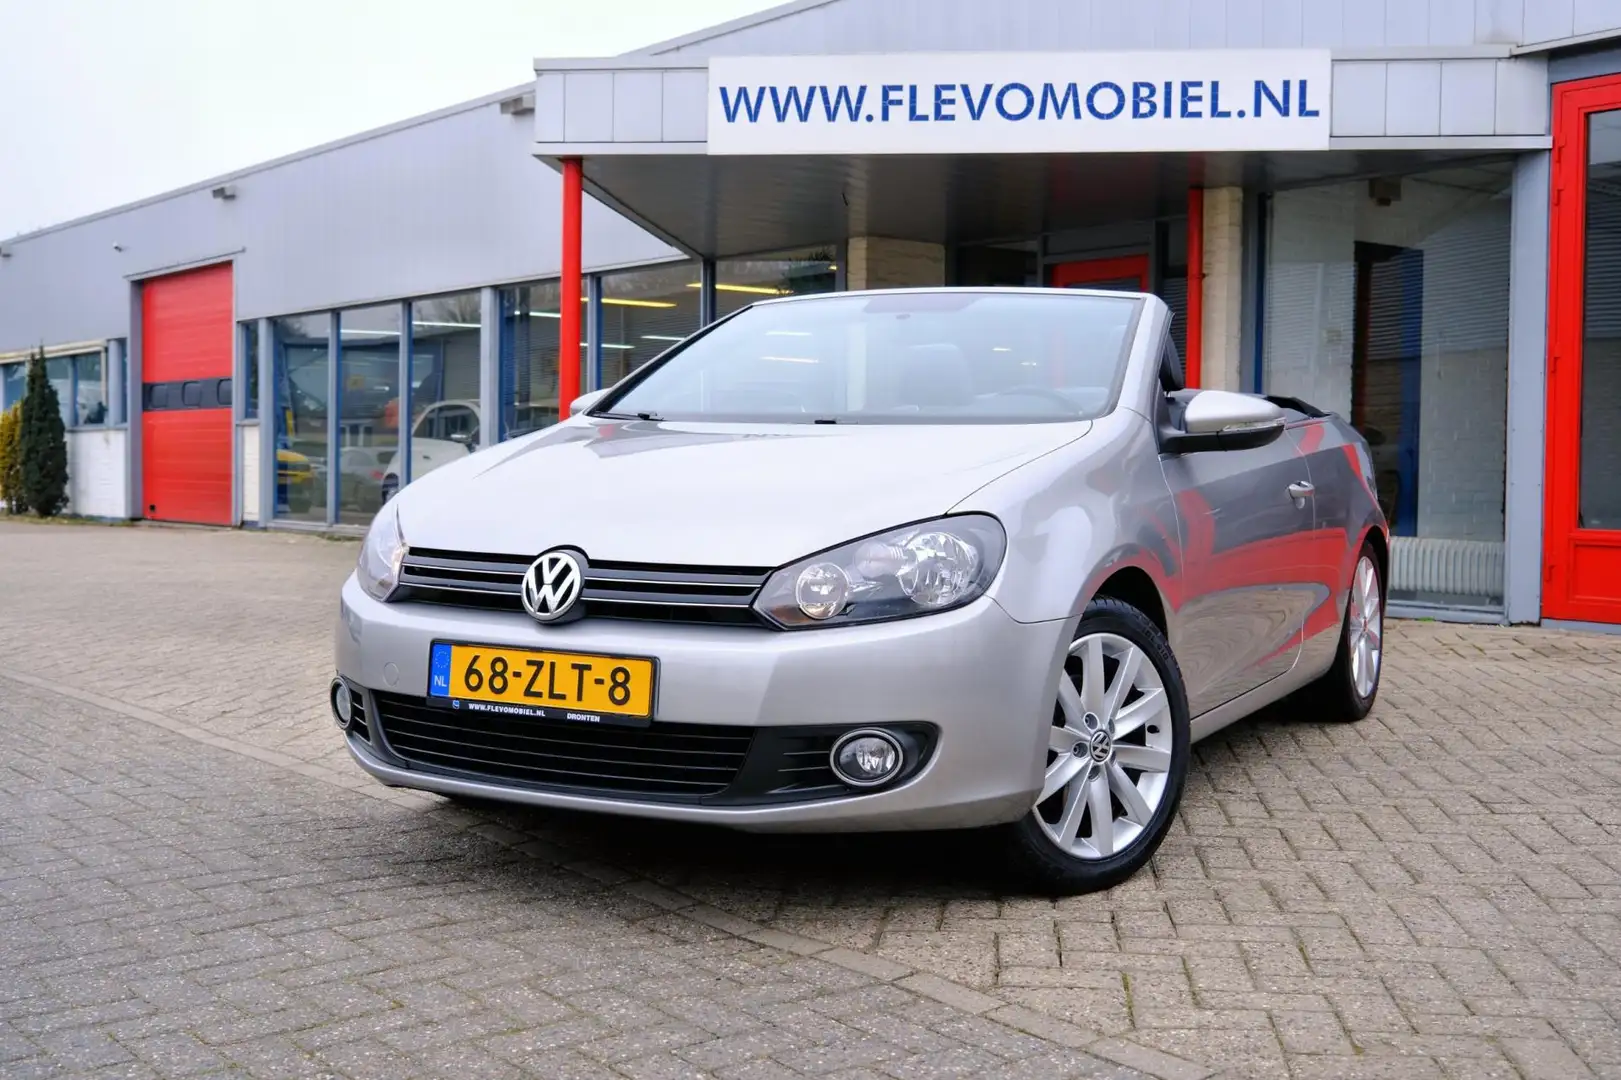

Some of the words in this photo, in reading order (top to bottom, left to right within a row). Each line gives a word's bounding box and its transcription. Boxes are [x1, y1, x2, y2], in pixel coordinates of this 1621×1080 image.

[719, 79, 1320, 123] WWW.FLEVOMOBIEL.NL
[522, 554, 579, 618] VW
[434, 675, 447, 687] NL
[464, 655, 630, 706] 68-ZLT-8
[468, 703, 546, 717] WWW.FLEVOMOBIEL.NL
[567, 712, 600, 723] DRONTEN
